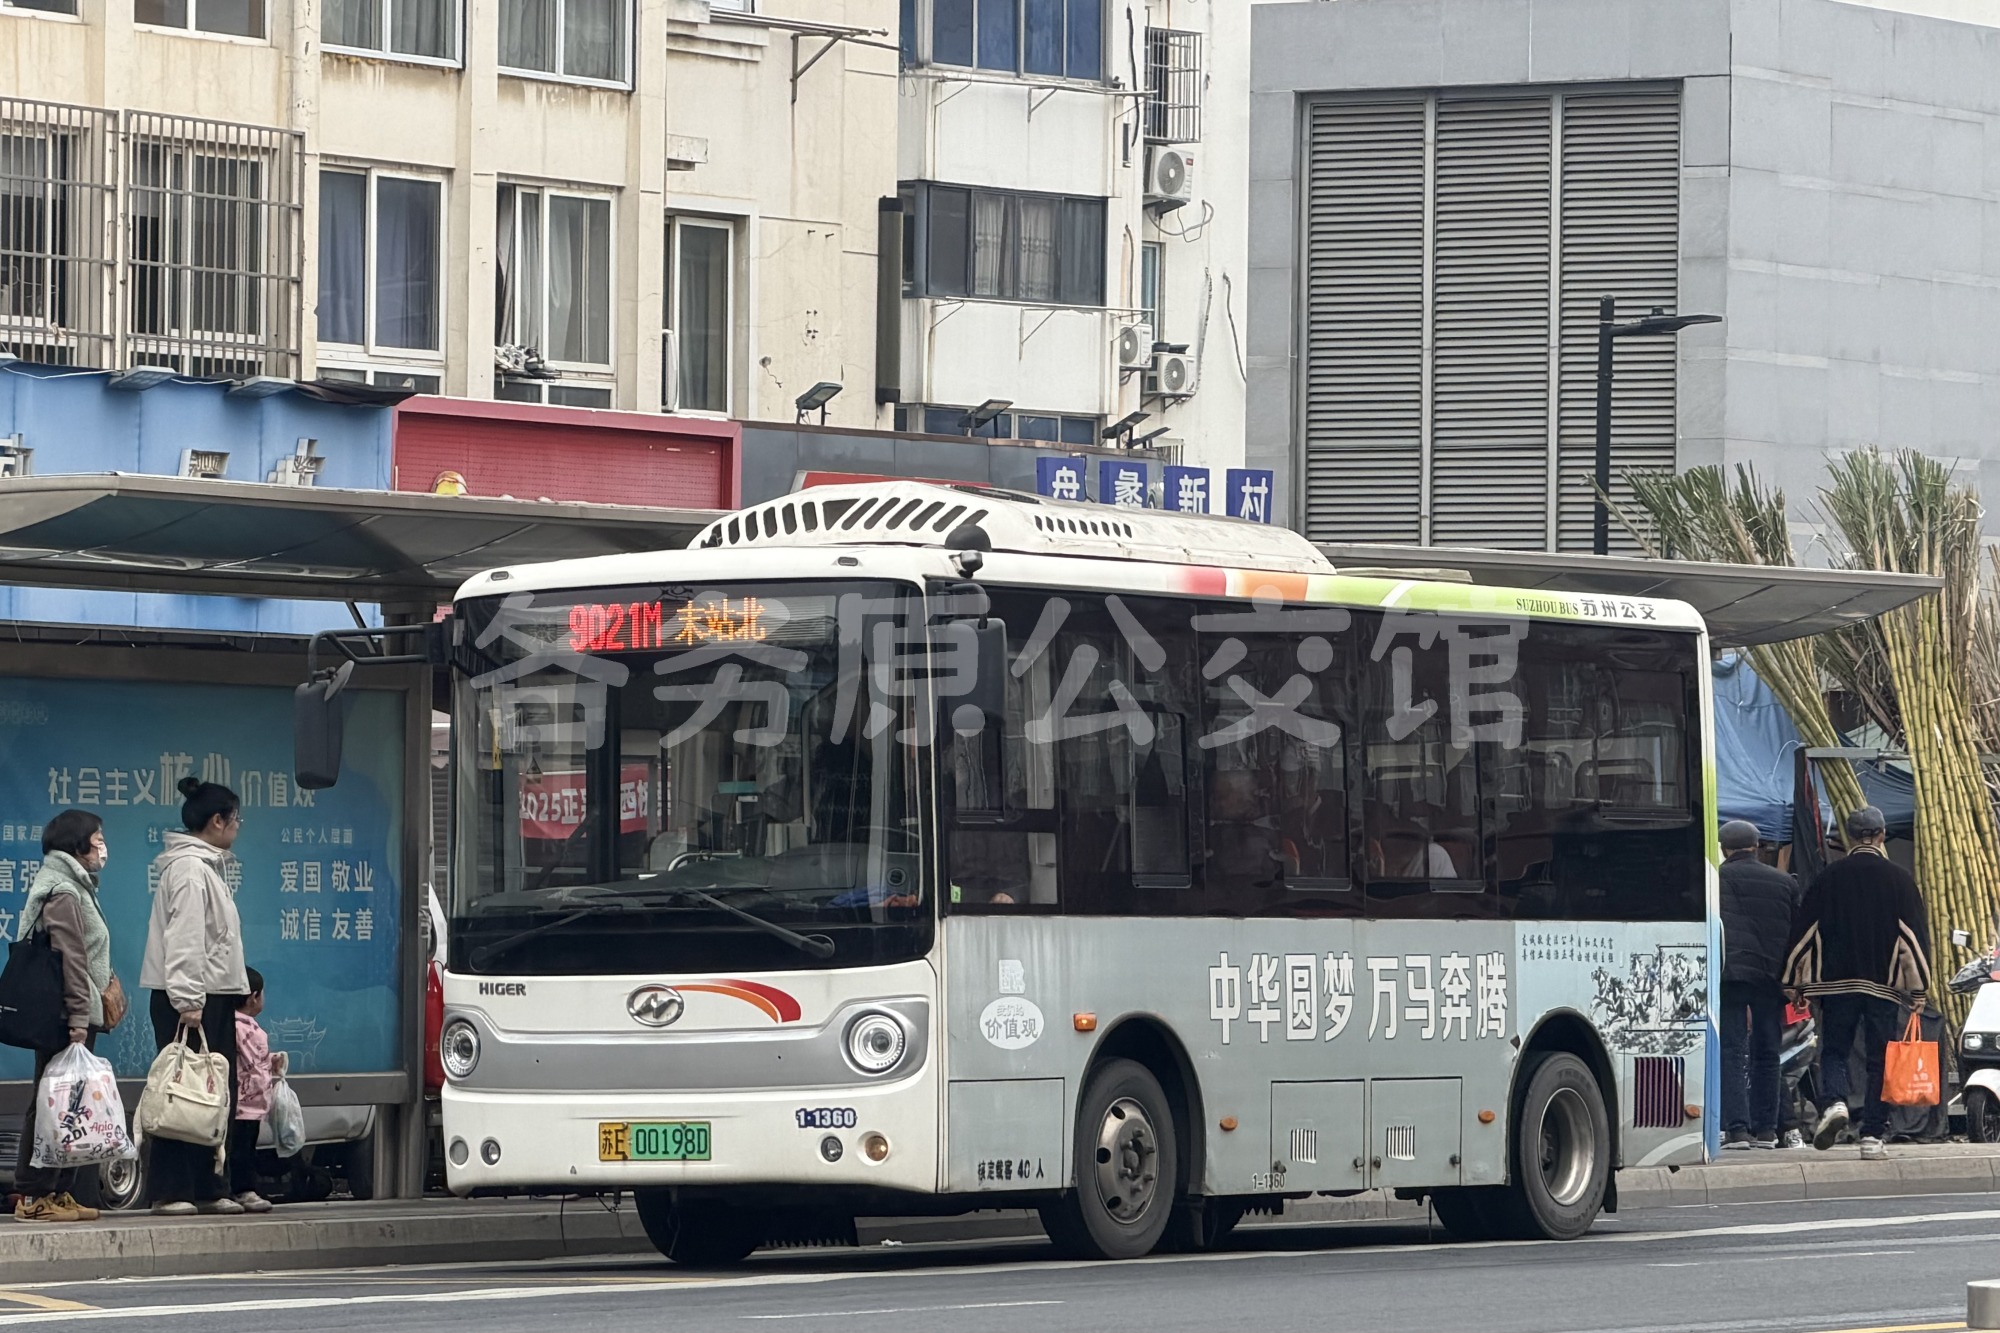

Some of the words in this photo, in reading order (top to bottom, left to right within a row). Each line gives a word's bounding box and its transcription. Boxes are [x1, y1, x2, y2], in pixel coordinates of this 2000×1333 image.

[1516, 598, 1558, 614] SUZHOU
[1559, 601, 1579, 616] BUS
[1580, 598, 1657, 620] 苏州公交
[569, 601, 663, 652] 9021M
[281, 827, 352, 844] 公民个人层面
[281, 861, 321, 893] 爱国
[332, 860, 373, 892] 敬业
[280, 907, 321, 940] 诚信
[332, 907, 373, 940] 友善
[479, 982, 527, 996] HIGER
[1209, 951, 1354, 1044] 中华圆梦
[1366, 951, 1508, 1041] 万马奔腾
[985, 1017, 1038, 1040] 价值观
[1017, 1159, 1031, 1179] 40
[1035, 1157, 1044, 1179] 人
